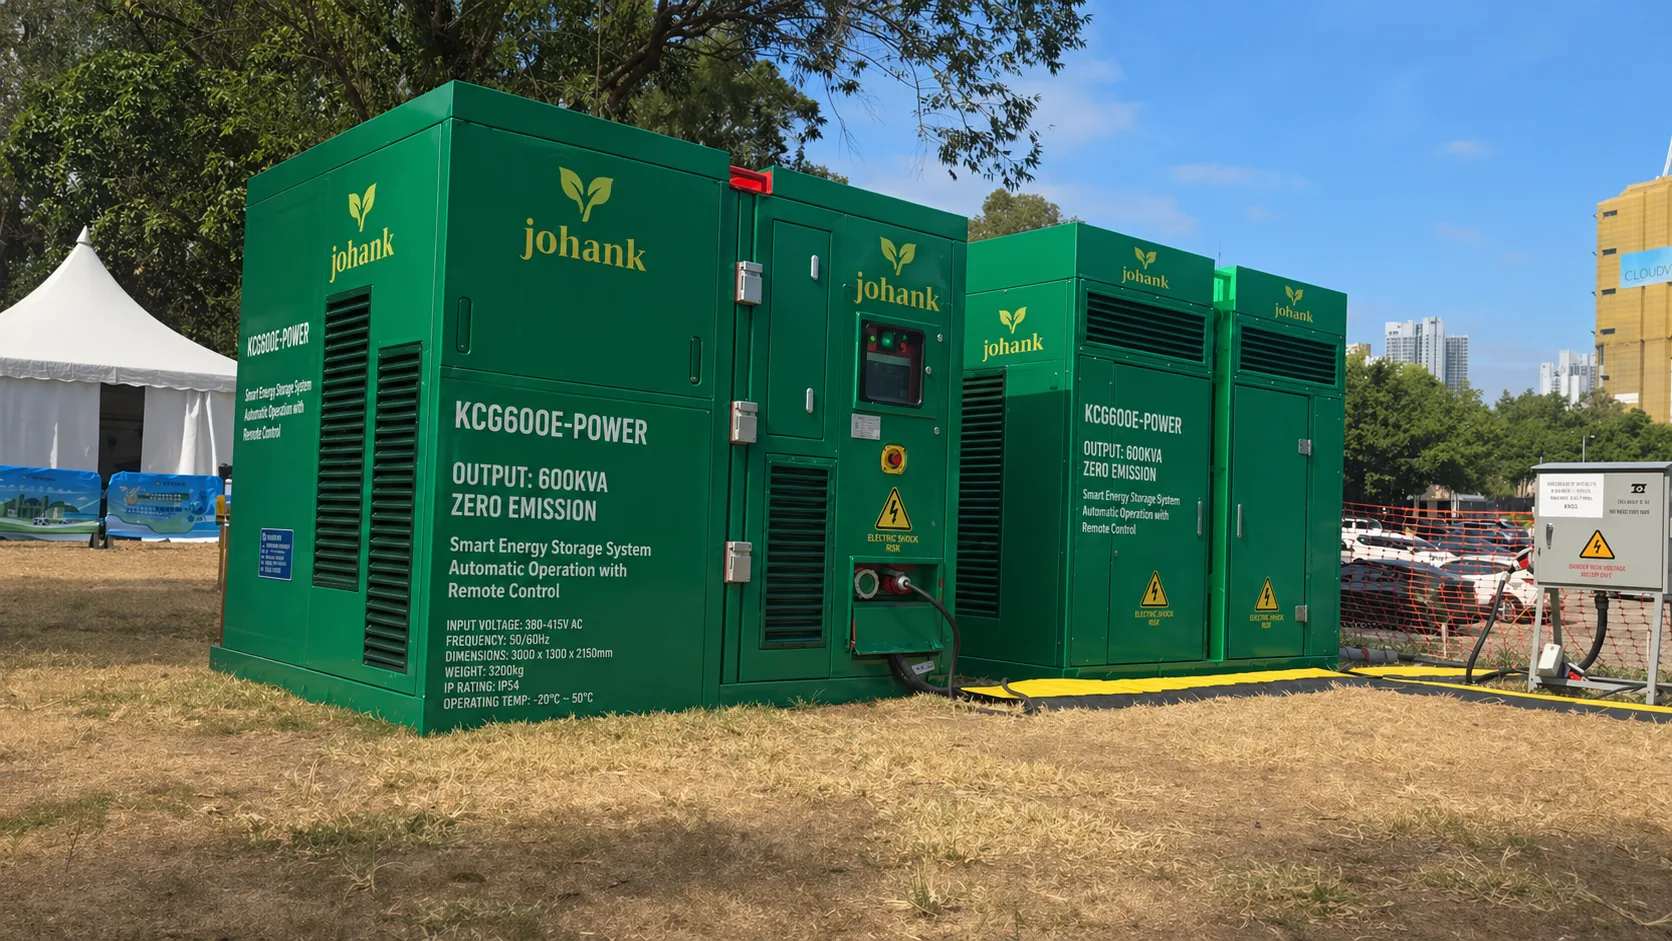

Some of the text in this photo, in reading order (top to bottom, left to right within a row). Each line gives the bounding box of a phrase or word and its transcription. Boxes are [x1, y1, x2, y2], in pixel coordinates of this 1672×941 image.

[520, 218, 646, 271] johank
[330, 227, 394, 283] johank
[1121, 266, 1168, 290] johank
[854, 271, 939, 312] johank
[1275, 302, 1314, 323] johank
[982, 333, 1044, 362] johank
[456, 401, 647, 445] KCG600E-POWER
[1085, 404, 1181, 434] KCG600E-POWER
[1084, 441, 1162, 463] OUTPUT: 600KVA
[453, 462, 607, 492] OUTPUT: 600KVA
[1084, 461, 1156, 481] ZERO EMISSION
[451, 493, 596, 521] ZERO EMISSION
[1083, 489, 1180, 506] Smart Energy Storage System
[1083, 505, 1169, 520] Automatic Operation with
[1082, 522, 1136, 534] Remote Control
[450, 537, 651, 559] Smart Energy Storage System
[449, 560, 626, 579] Automatic Operation with
[449, 583, 559, 598] Remote Control
[447, 619, 582, 631] INPUT VOLTAGE: 380-415V AC
[446, 635, 506, 646] FREQUENCY:
[446, 650, 508, 662] DIMENSIONS:
[511, 650, 535, 660] 3000
[546, 649, 566, 659] 1300
[576, 648, 612, 658] 2150mm
[445, 665, 524, 677] WEIGHT: 3200kg
[445, 680, 519, 693] IP RATING: IP54
[444, 696, 499, 709] OPERATING
[502, 695, 530, 706] TEMP:
